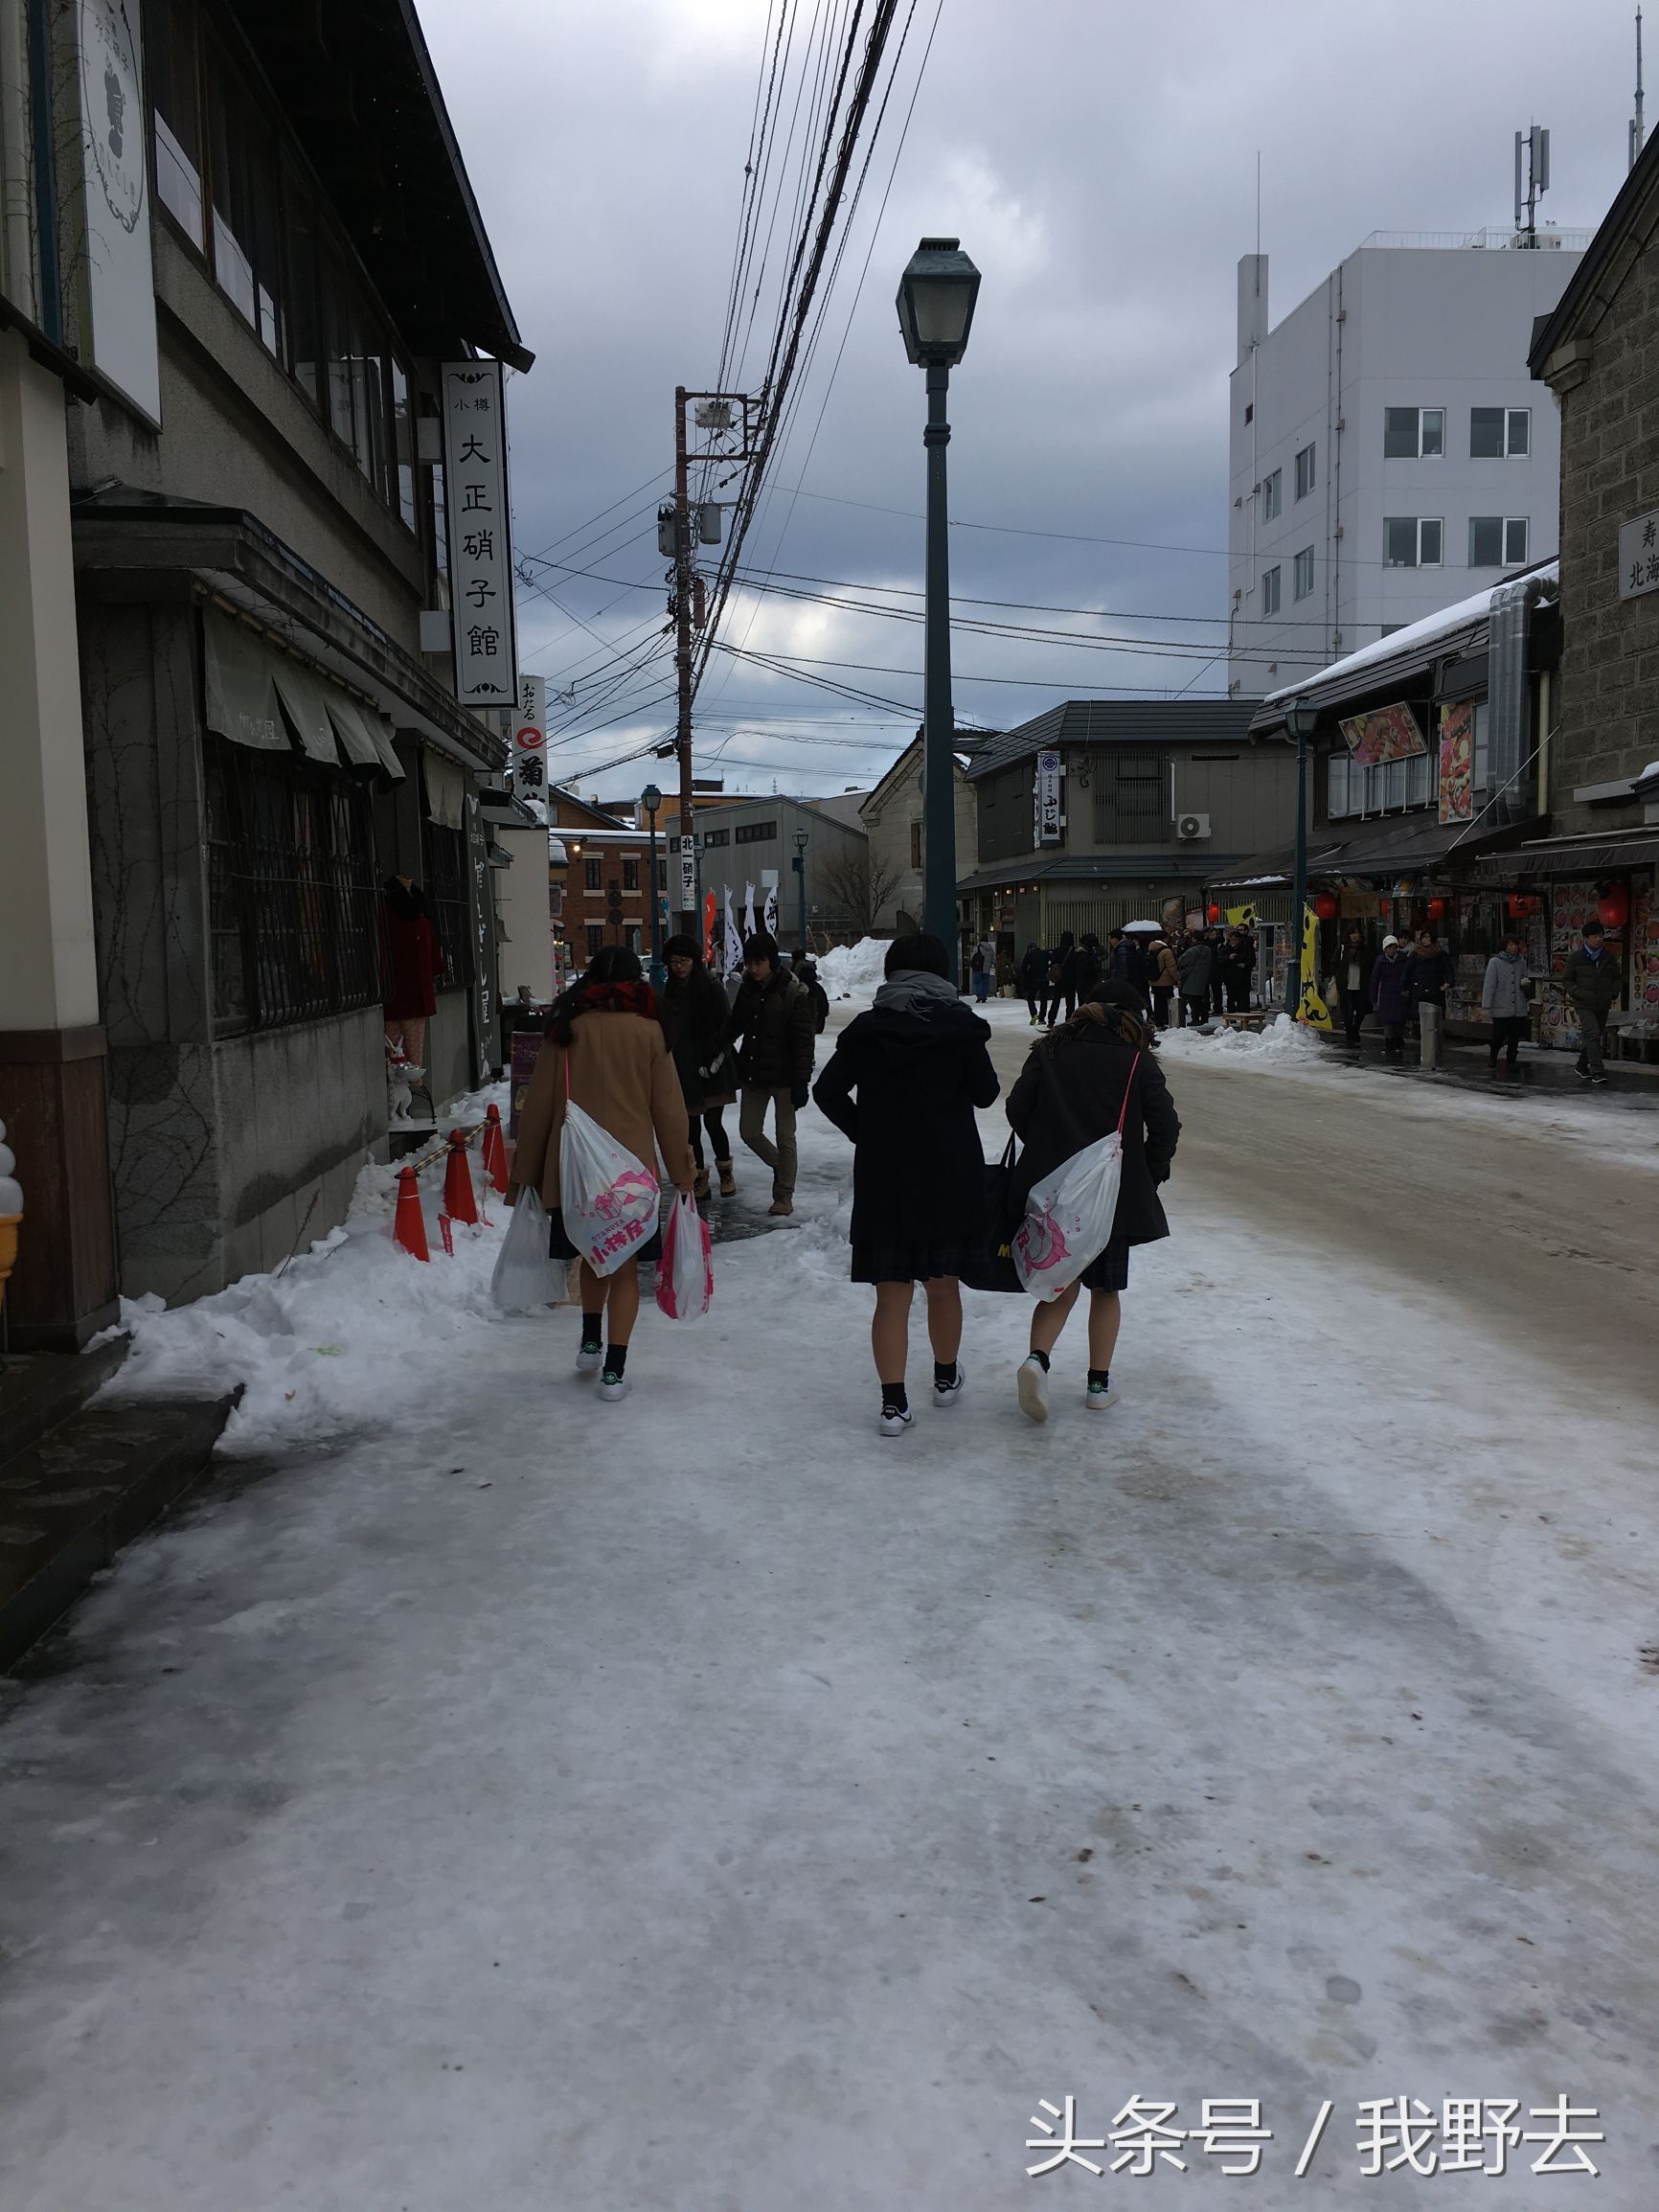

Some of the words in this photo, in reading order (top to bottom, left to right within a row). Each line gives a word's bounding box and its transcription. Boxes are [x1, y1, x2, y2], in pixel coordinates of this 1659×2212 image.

[453, 398, 491, 412] 小樽
[460, 434, 500, 656] 大正硝子館
[1642, 519, 1657, 549] 寿
[522, 682, 535, 721] おたる
[682, 836, 693, 888] 北一硝子
